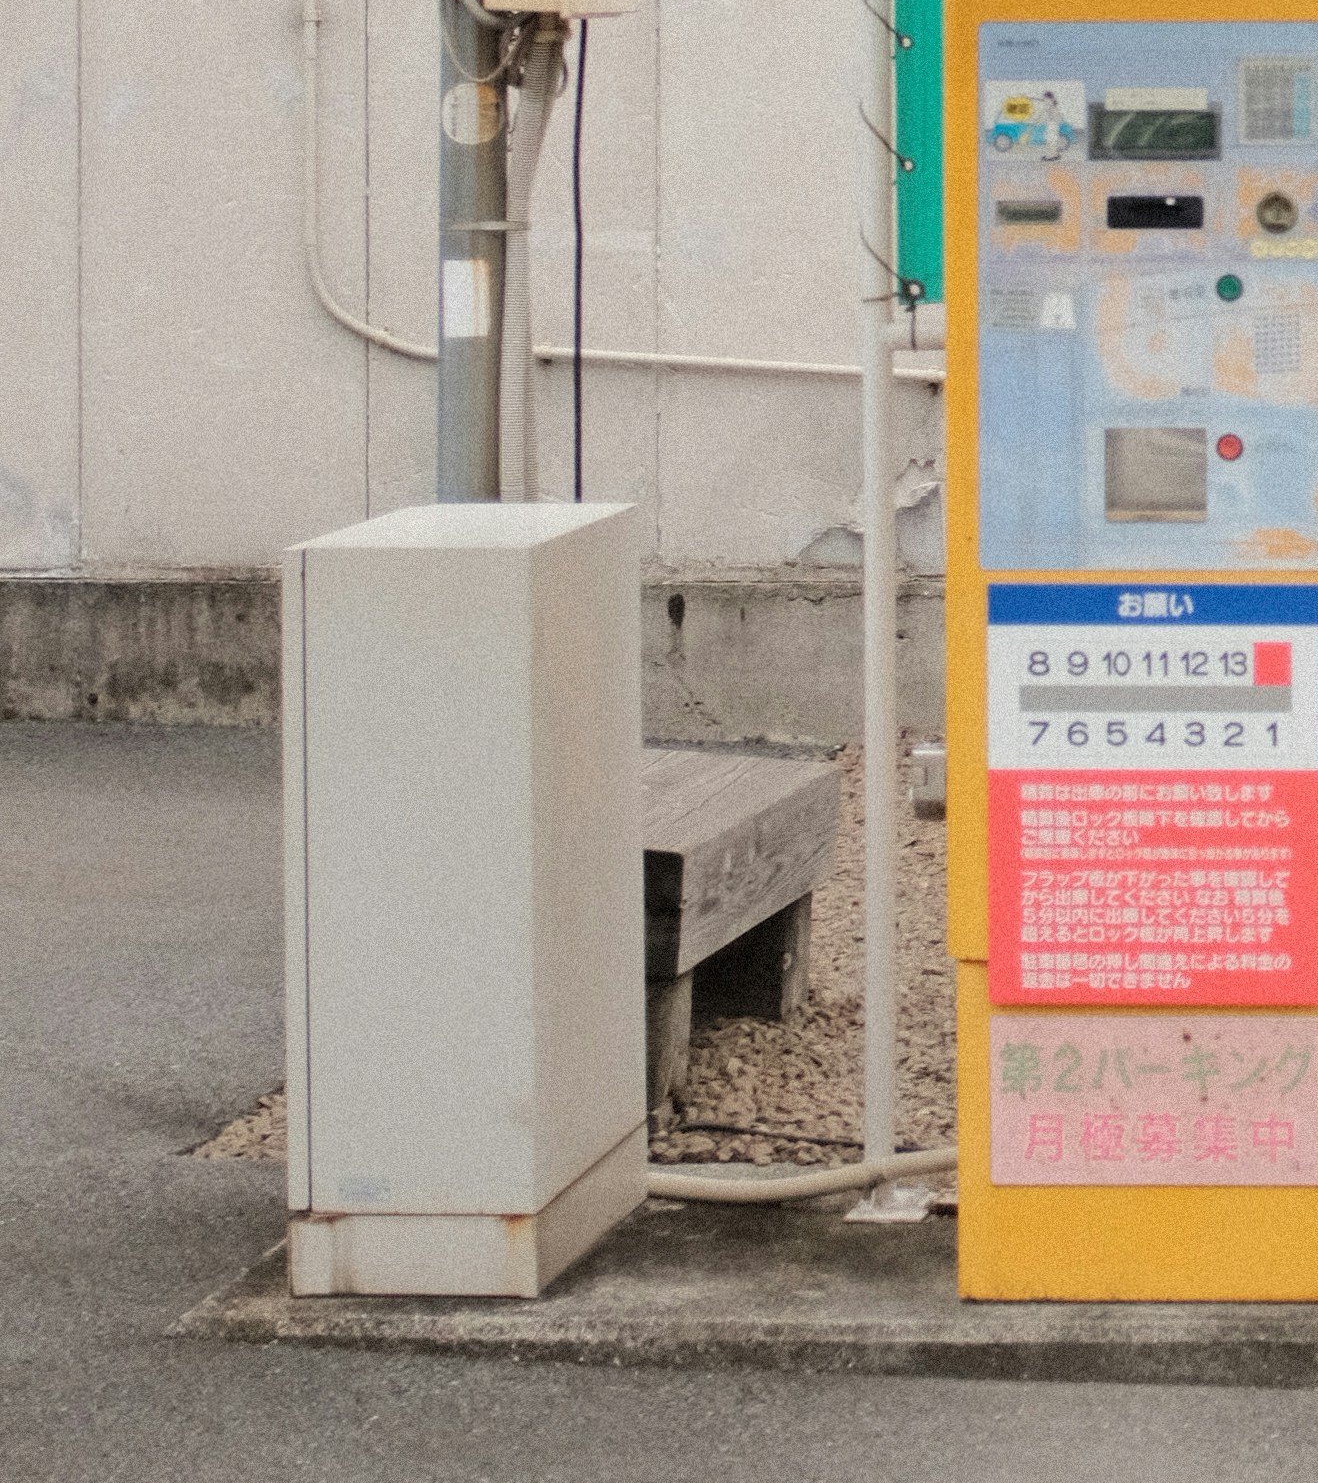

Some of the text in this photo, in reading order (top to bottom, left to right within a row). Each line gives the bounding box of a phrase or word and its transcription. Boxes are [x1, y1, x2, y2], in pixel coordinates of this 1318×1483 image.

[1118, 592, 1194, 617] お願い
[1027, 651, 1247, 676] 8 9 10 11 12 13
[1028, 721, 1278, 747] 7 6 5 4 3 2 1
[1024, 1113, 1295, 1163] 月極募集中
